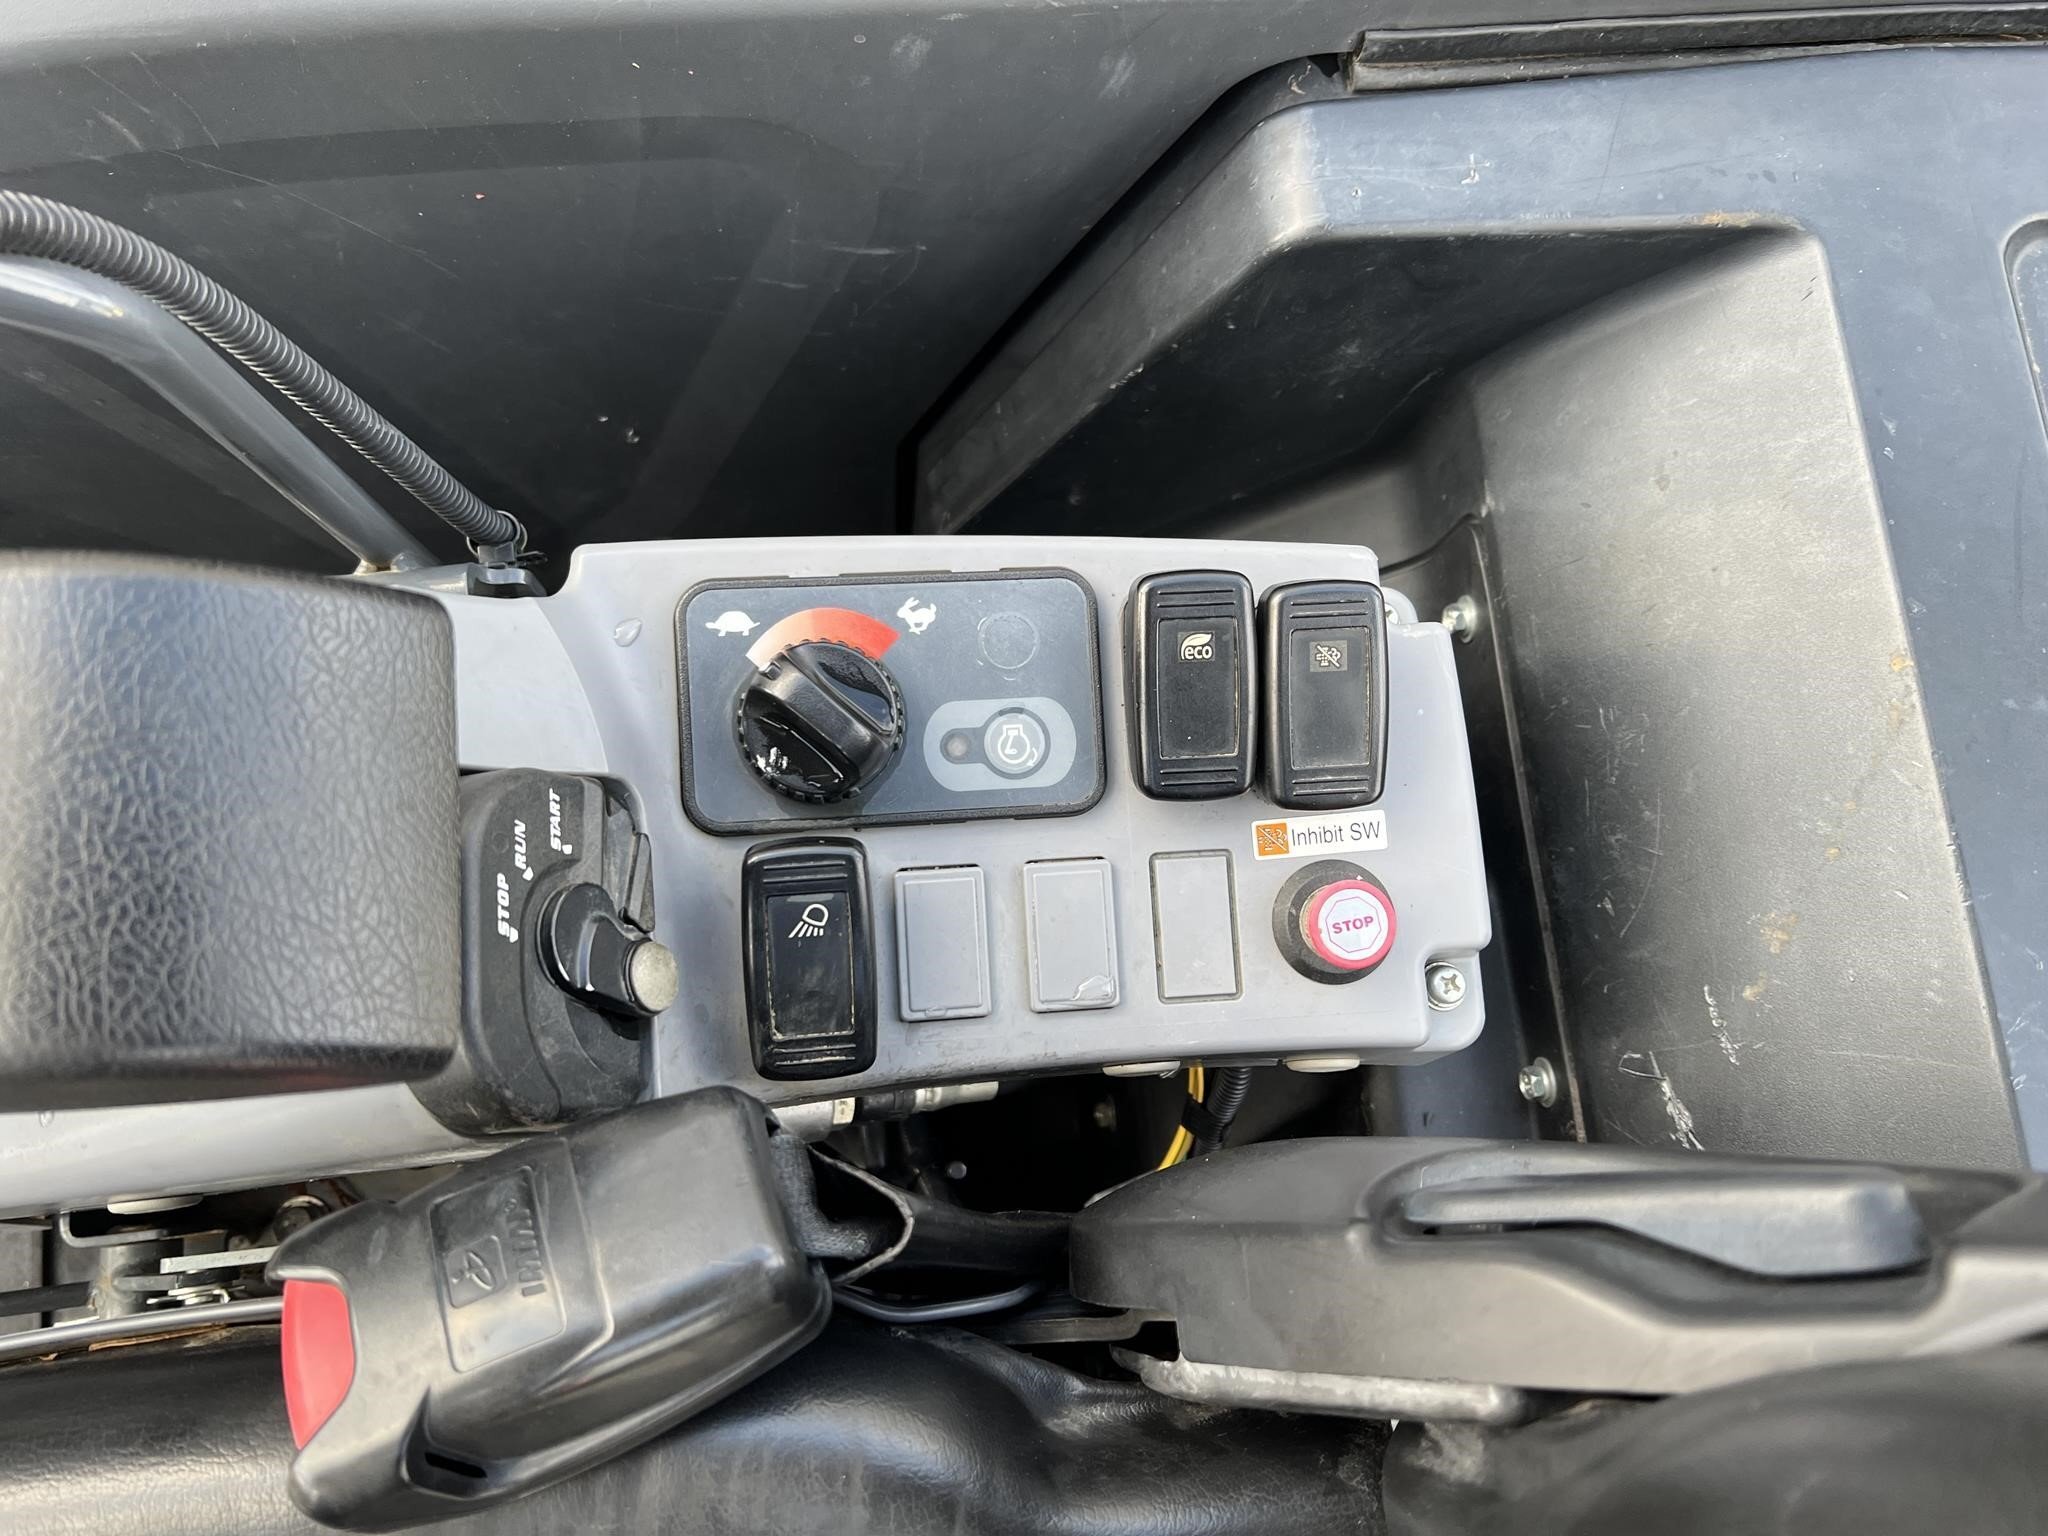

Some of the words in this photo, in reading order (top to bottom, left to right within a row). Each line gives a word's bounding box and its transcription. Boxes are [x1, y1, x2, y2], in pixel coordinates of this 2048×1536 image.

[1184, 645, 1213, 660] eco
[549, 787, 562, 851] START
[1291, 825, 1345, 846] Inhibit
[1350, 820, 1381, 841] SW
[514, 819, 527, 870] RUN
[497, 872, 511, 938] STOP
[1332, 915, 1374, 934] STOP
